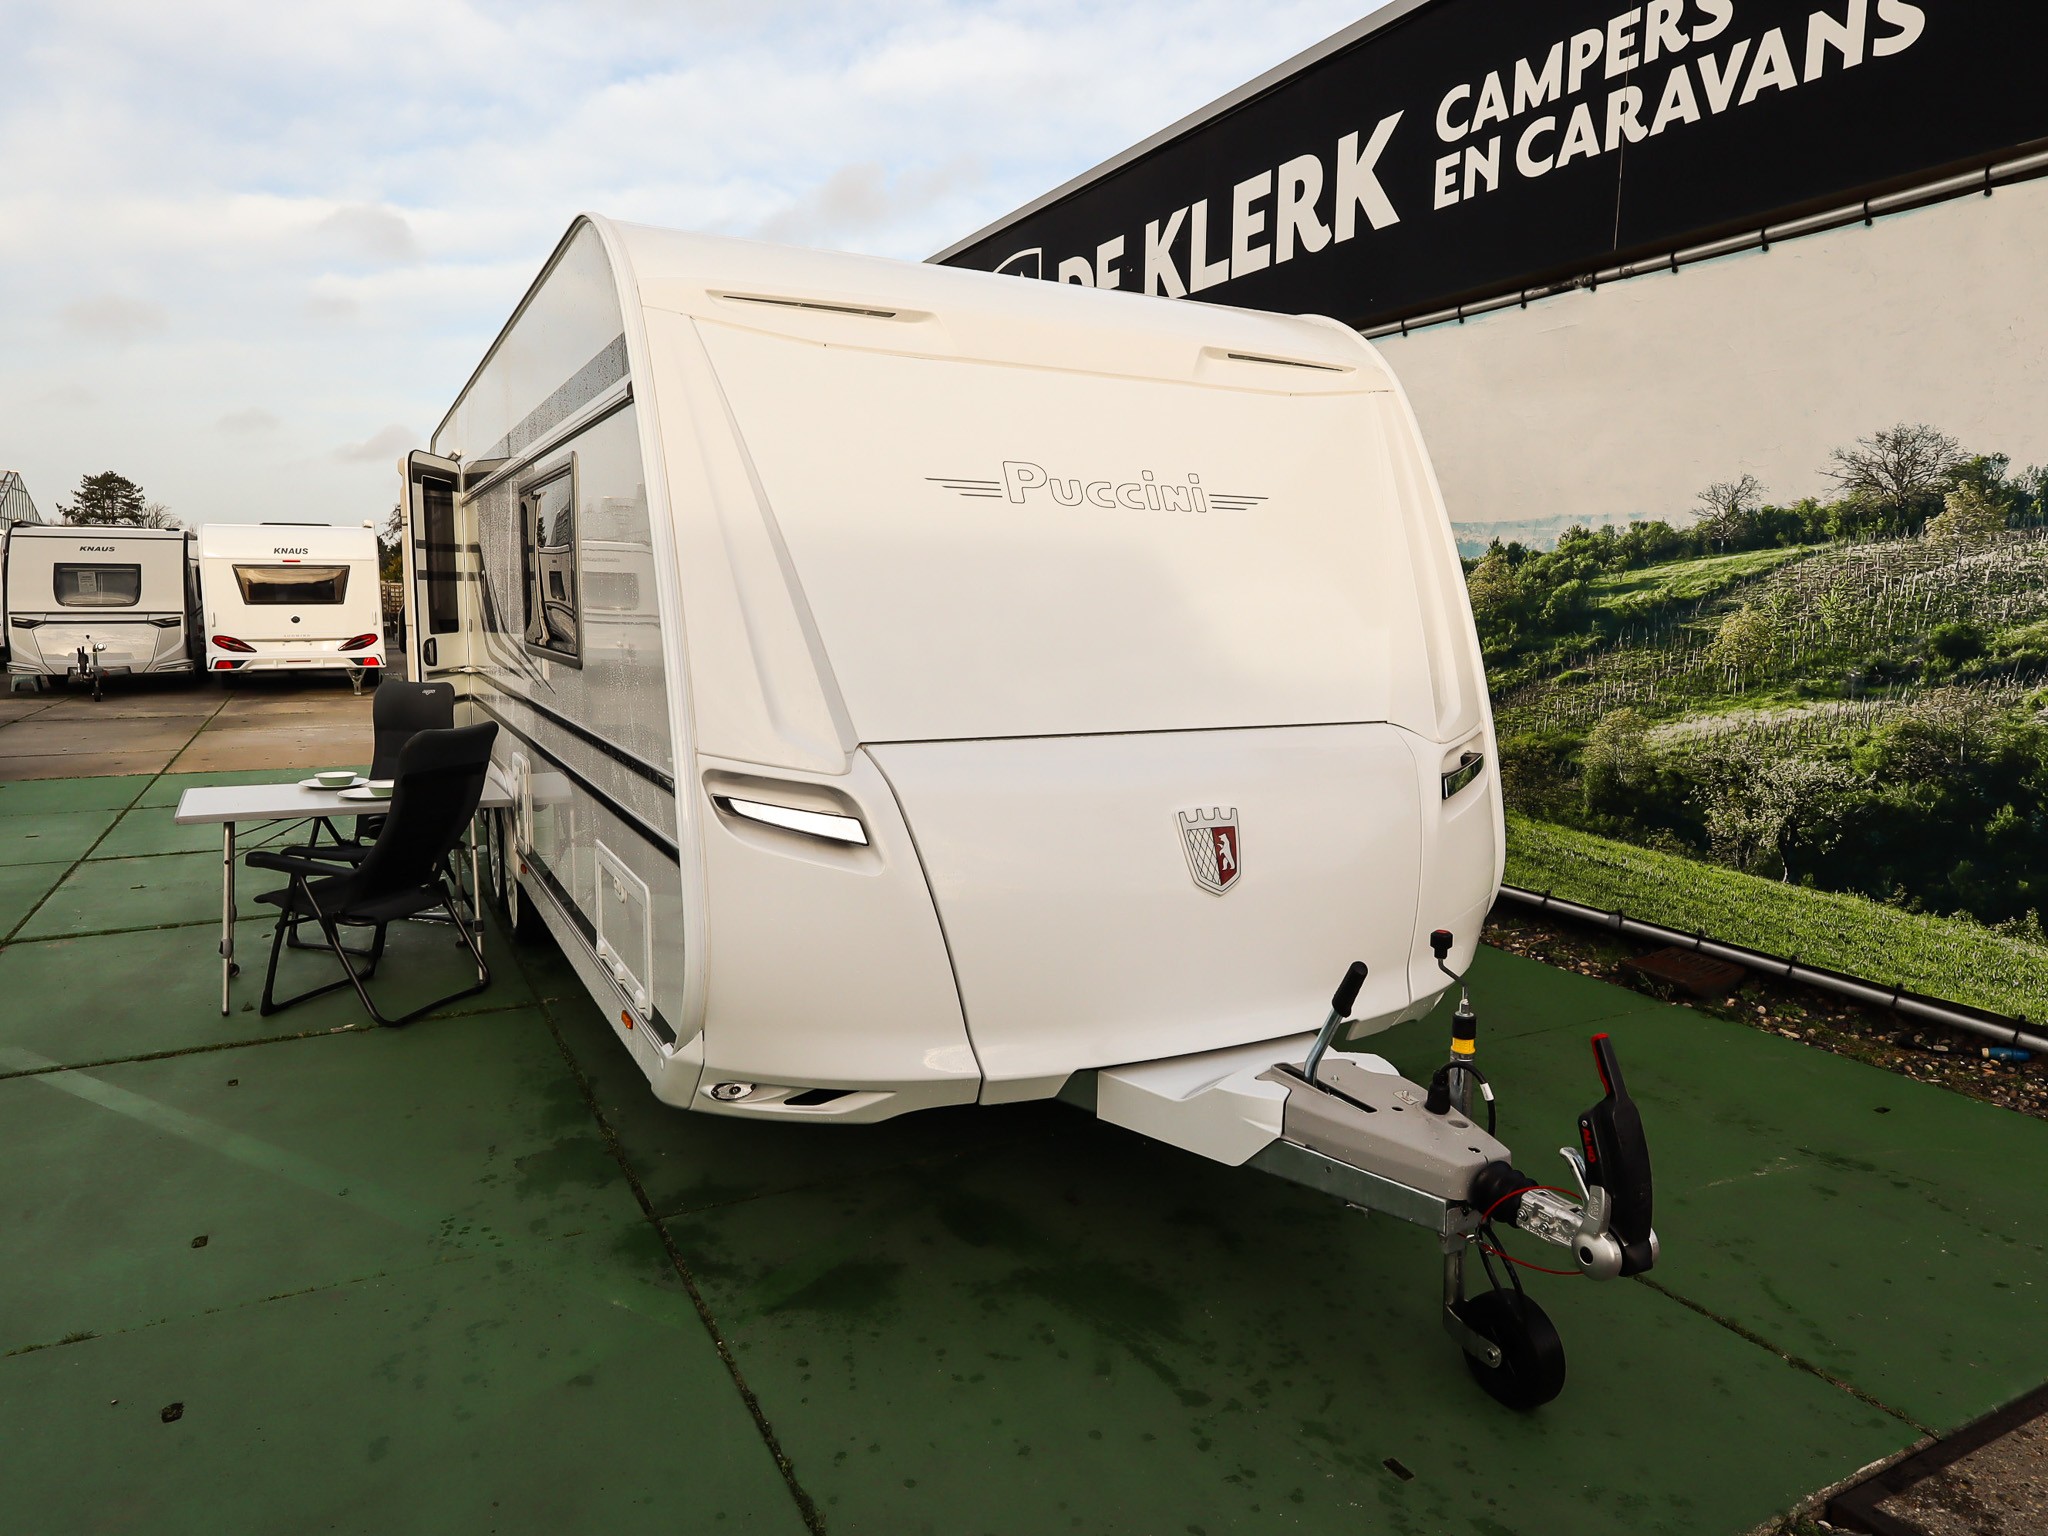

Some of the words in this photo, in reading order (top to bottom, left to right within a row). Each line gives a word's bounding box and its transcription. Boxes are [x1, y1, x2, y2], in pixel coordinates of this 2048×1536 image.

[1434, 136, 1501, 211] EN
[1515, 0, 1926, 178] CARAVANS
[1435, 0, 1733, 143] CAMPERS
[1144, 109, 1405, 299] KLERK
[273, 547, 309, 555] KNAUS
[1002, 460, 1207, 513] Puccini
